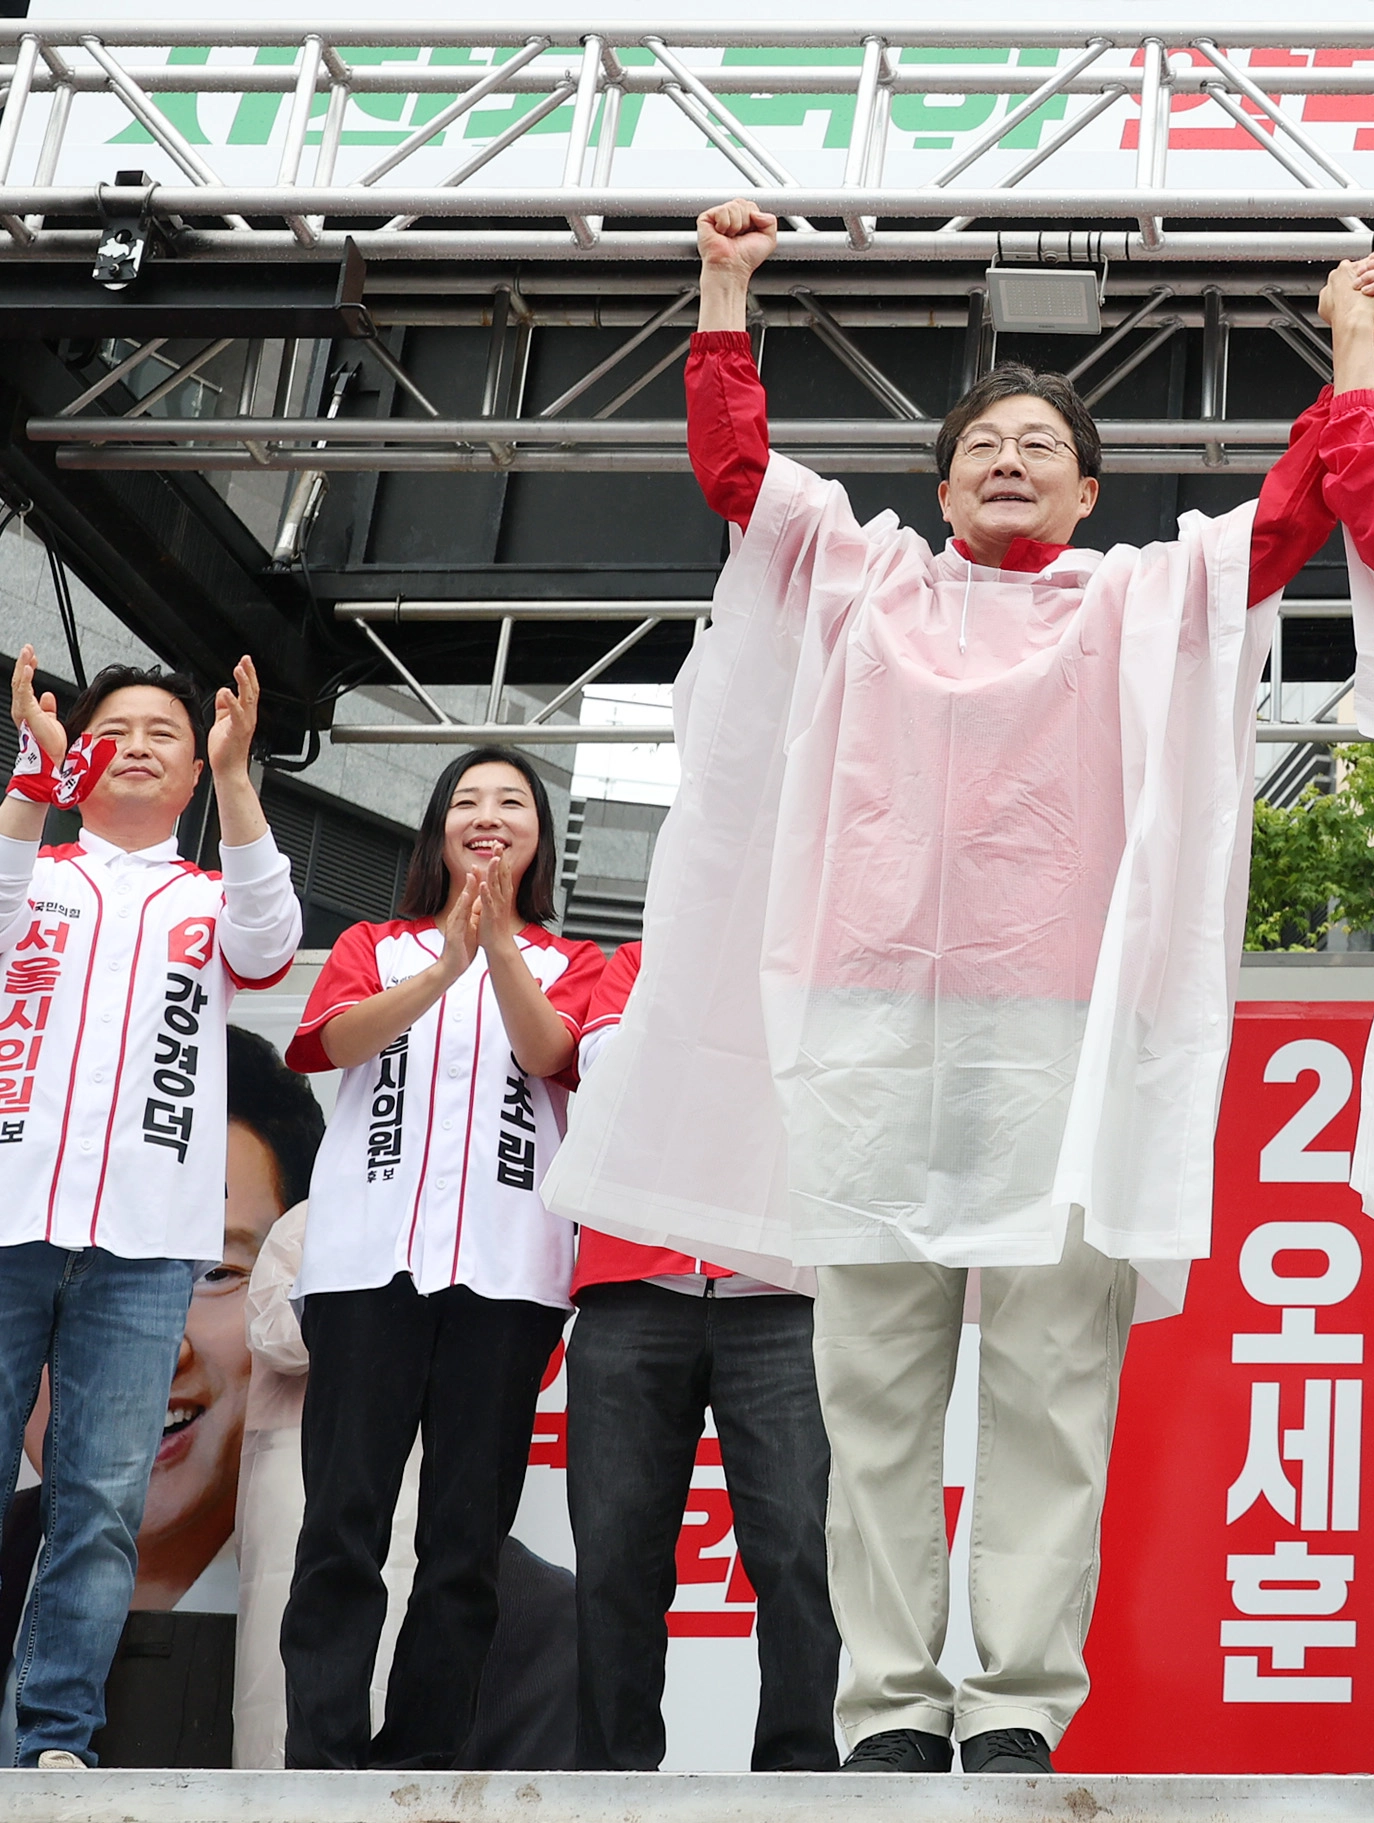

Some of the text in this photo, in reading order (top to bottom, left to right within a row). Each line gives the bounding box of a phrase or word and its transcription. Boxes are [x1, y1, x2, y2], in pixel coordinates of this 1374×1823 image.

[183, 923, 212, 962] 2
[142, 972, 209, 1165] 강경덕
[497, 1050, 536, 1191] 초립
[366, 1168, 394, 1184] 후보
[1219, 1038, 1364, 1703] 2 오세훈
